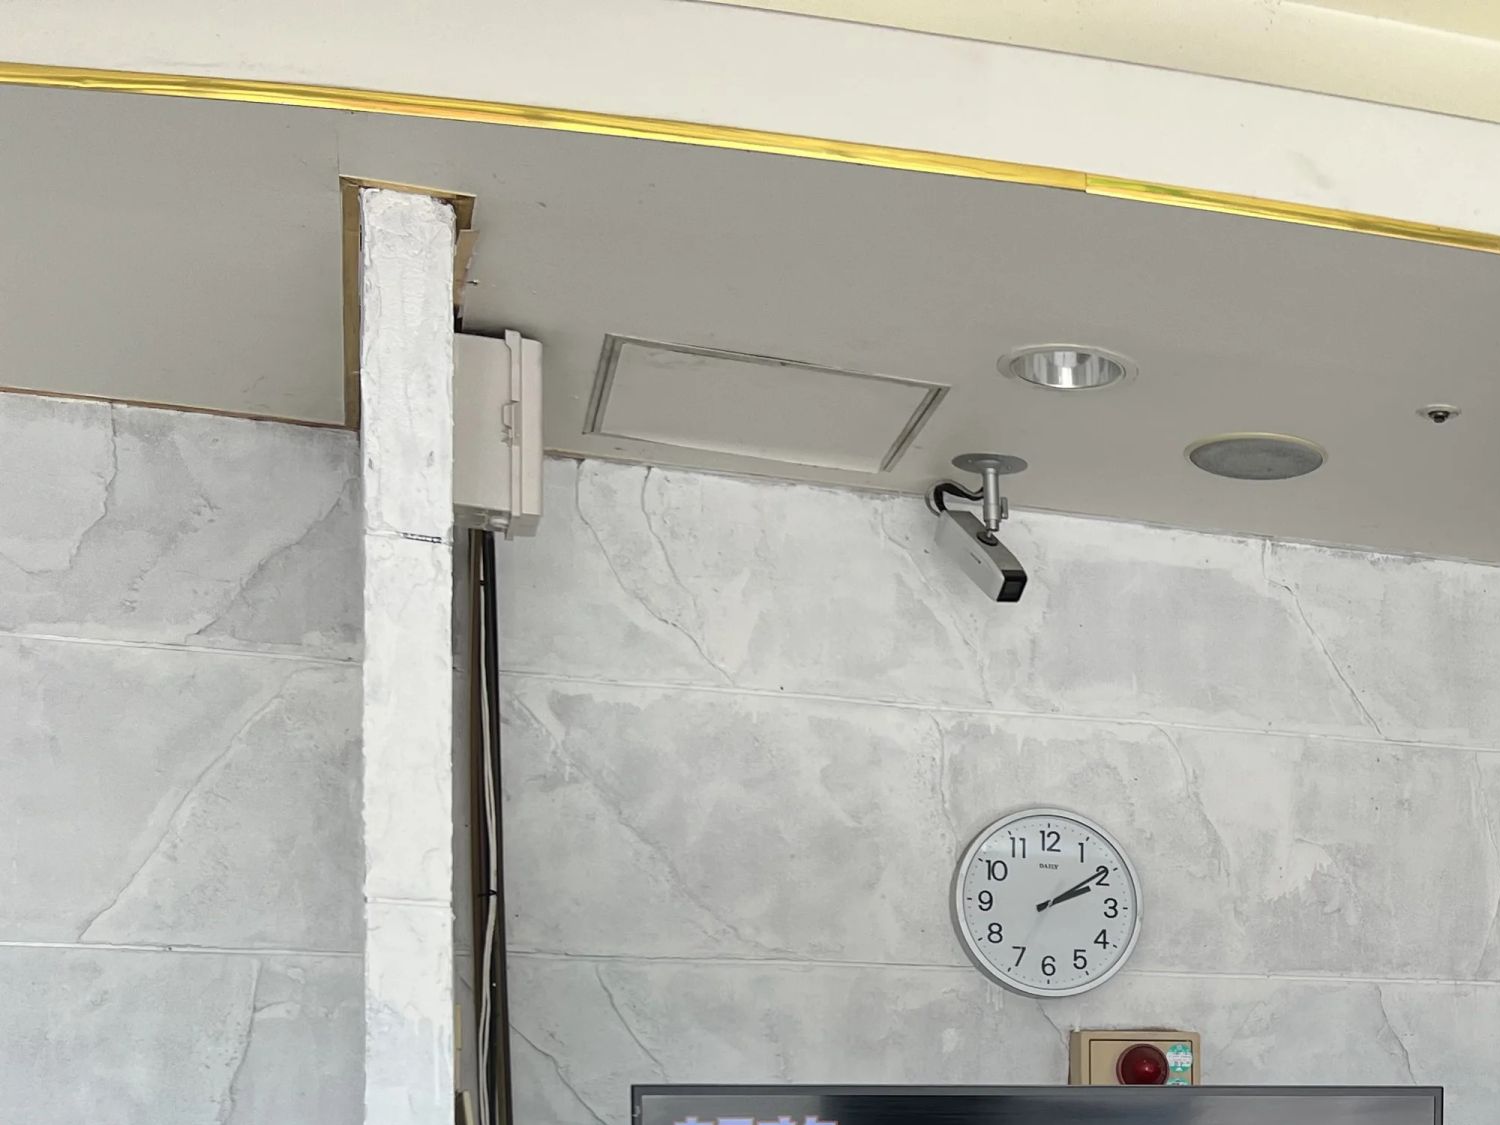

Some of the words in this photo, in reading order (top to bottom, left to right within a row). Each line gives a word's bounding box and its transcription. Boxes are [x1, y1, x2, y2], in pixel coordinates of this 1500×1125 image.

[1009, 837, 1026, 859] 11
[1040, 831, 1061, 852] 12
[1078, 842, 1085, 862] 1
[986, 860, 1008, 881] 10
[978, 890, 993, 911] 9
[1103, 898, 1118, 918] 3
[987, 922, 1003, 943] 8
[1094, 929, 1110, 949] 4
[1012, 946, 1026, 967] 7
[1041, 955, 1056, 976] 6
[1073, 949, 1087, 970] 5
